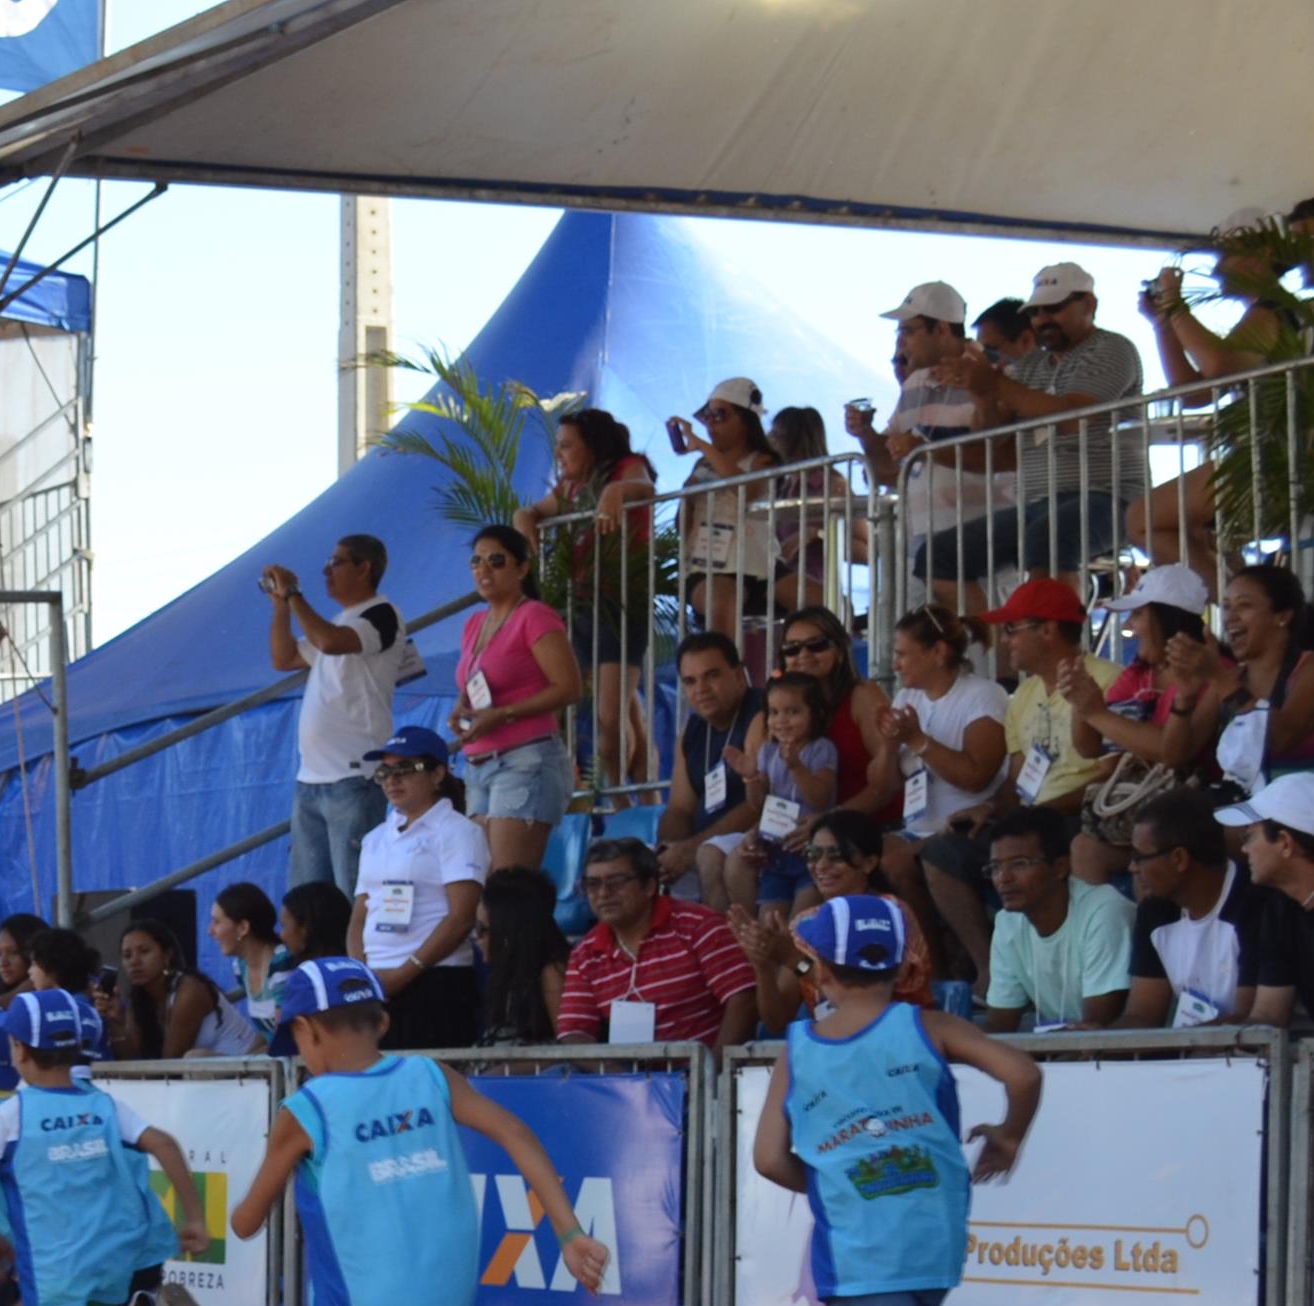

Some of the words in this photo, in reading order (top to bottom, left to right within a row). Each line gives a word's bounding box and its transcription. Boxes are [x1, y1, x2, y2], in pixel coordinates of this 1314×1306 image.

[40, 1113, 104, 1132] CAIXA
[355, 1108, 435, 1143] CAIXA
[966, 1233, 1105, 1275] Produções
[1114, 1240, 1180, 1274] Ltda
